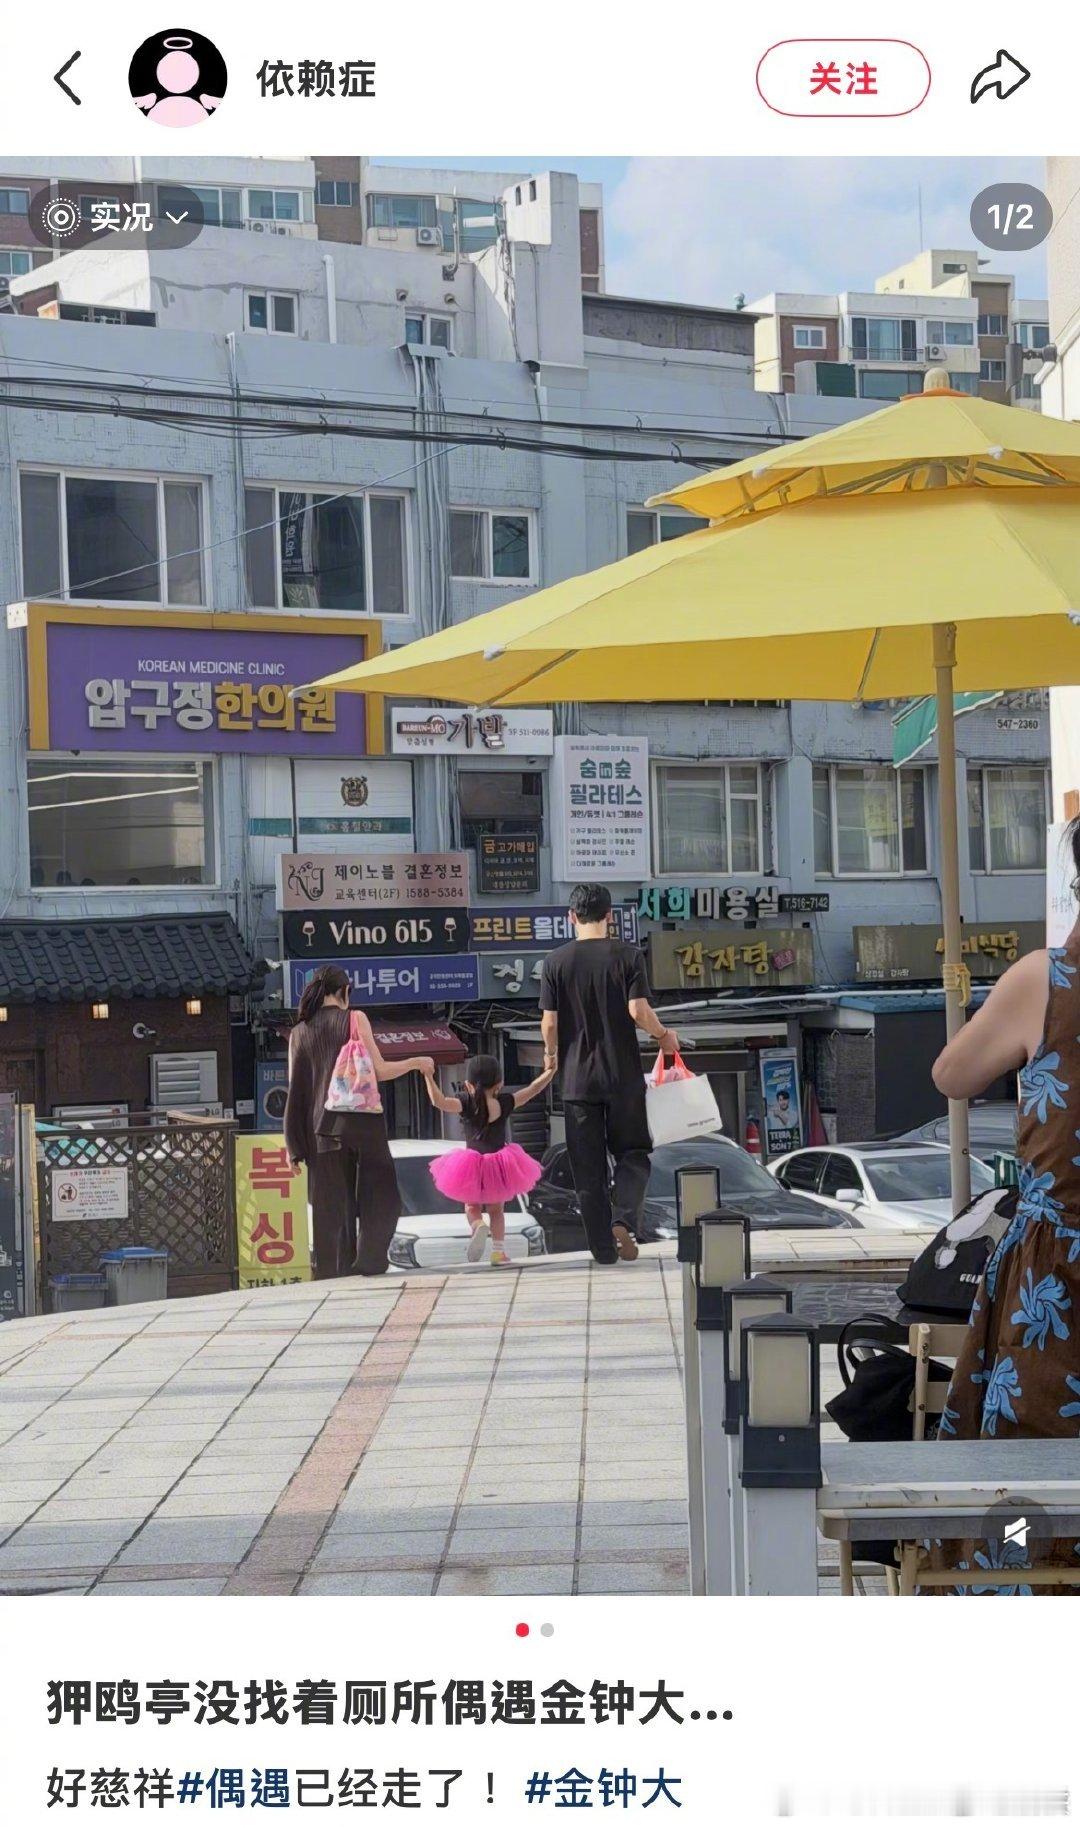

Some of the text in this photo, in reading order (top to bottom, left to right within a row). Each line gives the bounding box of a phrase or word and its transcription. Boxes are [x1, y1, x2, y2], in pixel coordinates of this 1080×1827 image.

[138, 660, 285, 676] KOREAN MEDICINE CLINIC
[85, 678, 337, 732] 압구정한의원
[447, 713, 507, 749] 가발
[569, 783, 643, 805] 필라테스
[334, 864, 463, 881] 제이노블 결혼정보
[406, 887, 463, 899] 1588-5384
[637, 886, 780, 921] 서희미용실
[329, 919, 433, 945] Vino 615
[473, 916, 577, 942] 프린트올데
[349, 966, 420, 996] 나투어
[492, 958, 544, 993] 정
[249, 1147, 296, 1265] 복싱
